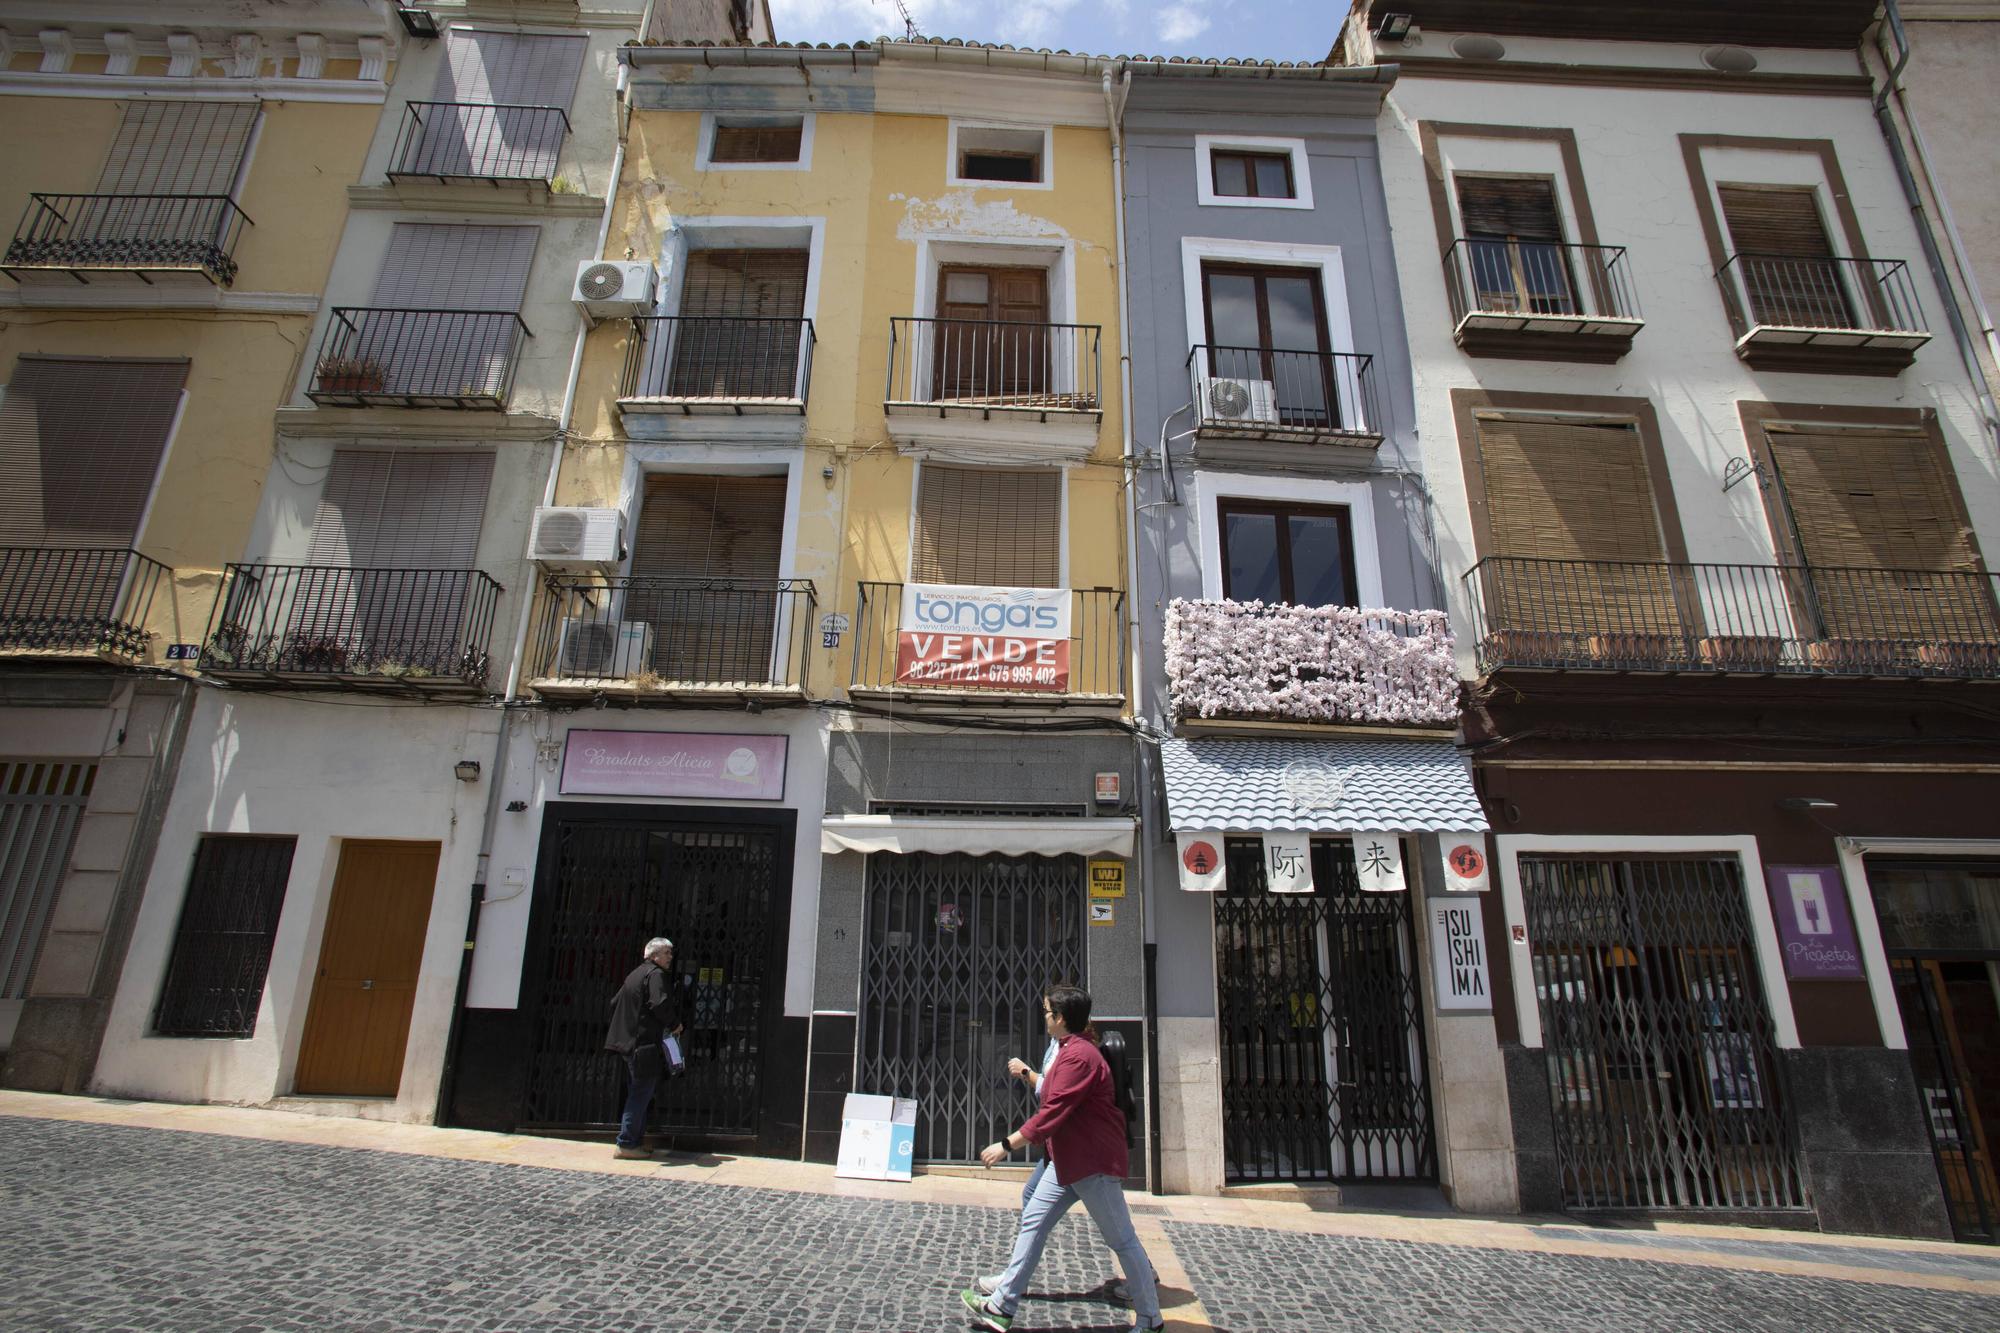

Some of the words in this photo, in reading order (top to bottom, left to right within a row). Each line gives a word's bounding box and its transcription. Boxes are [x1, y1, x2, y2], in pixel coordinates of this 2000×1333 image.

[170, 646, 179, 658] 2
[824, 634, 839, 647] 20
[911, 634, 1056, 664] VENDE
[910, 660, 924, 678] 96
[926, 661, 946, 680] 227
[966, 663, 980, 681] 23
[989, 665, 1009, 684] 675
[1012, 666, 1033, 684] 995
[1035, 667, 1056, 685] 402
[584, 748, 652, 768] Brodats
[655, 751, 713, 769] Alicia
[1271, 845, 1304, 879] 际
[1361, 841, 1395, 878] 来
